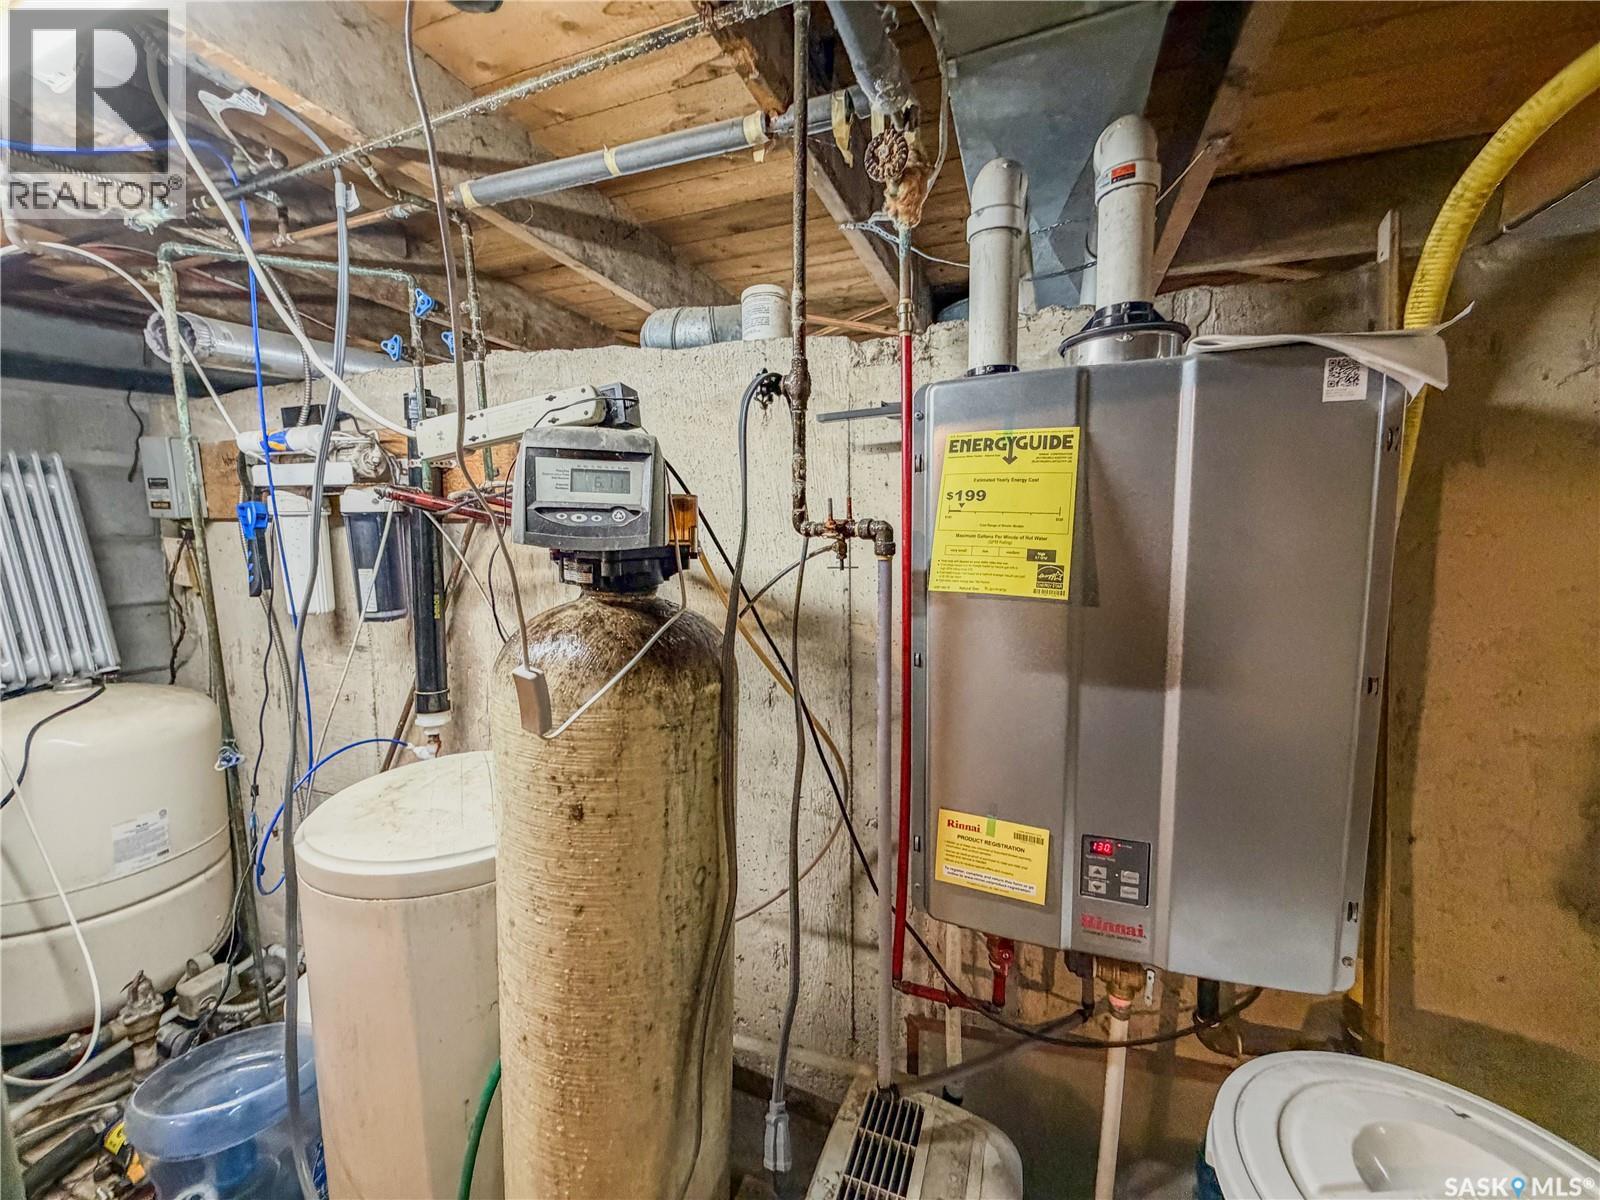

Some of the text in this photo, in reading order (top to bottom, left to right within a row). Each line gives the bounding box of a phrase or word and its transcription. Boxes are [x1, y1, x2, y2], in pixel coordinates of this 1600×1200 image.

[948, 434, 1075, 454] ENERGYGUIDE
[946, 489, 987, 502] $199
[946, 819, 981, 833] Rinnai
[957, 834, 1025, 853] PRODUCT REGISTRATION
